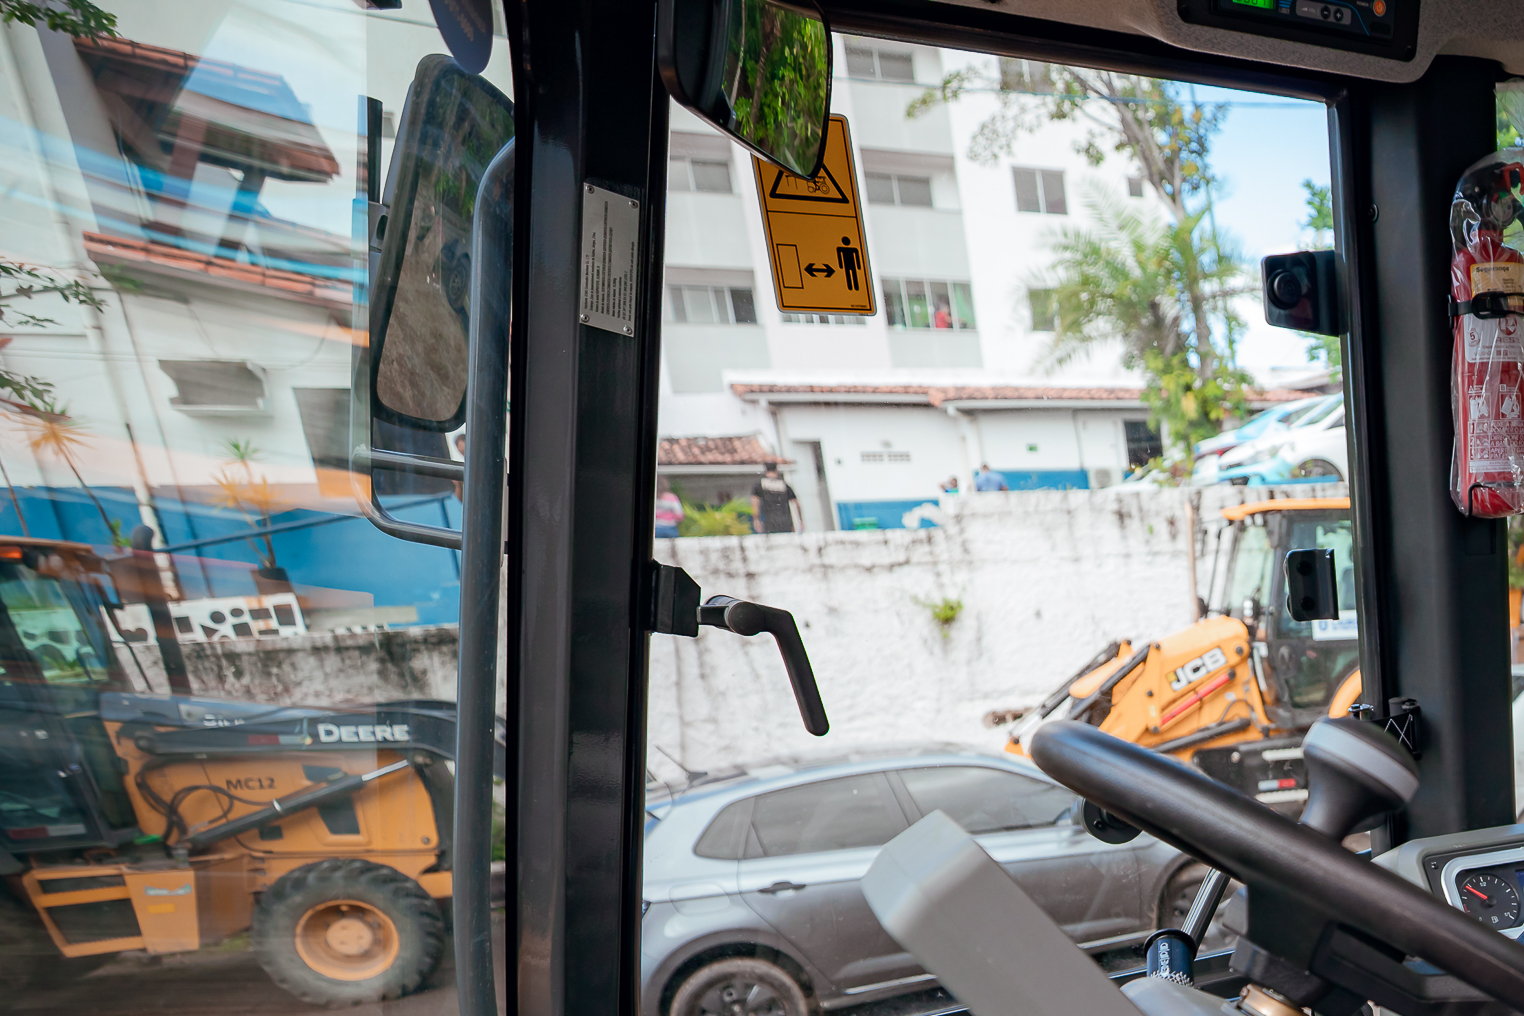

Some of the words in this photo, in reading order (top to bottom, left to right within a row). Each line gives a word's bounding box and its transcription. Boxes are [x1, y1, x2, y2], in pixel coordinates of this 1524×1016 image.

[1170, 646, 1228, 692] JCB
[317, 722, 412, 743] DEERE
[225, 776, 277, 791] MC12
